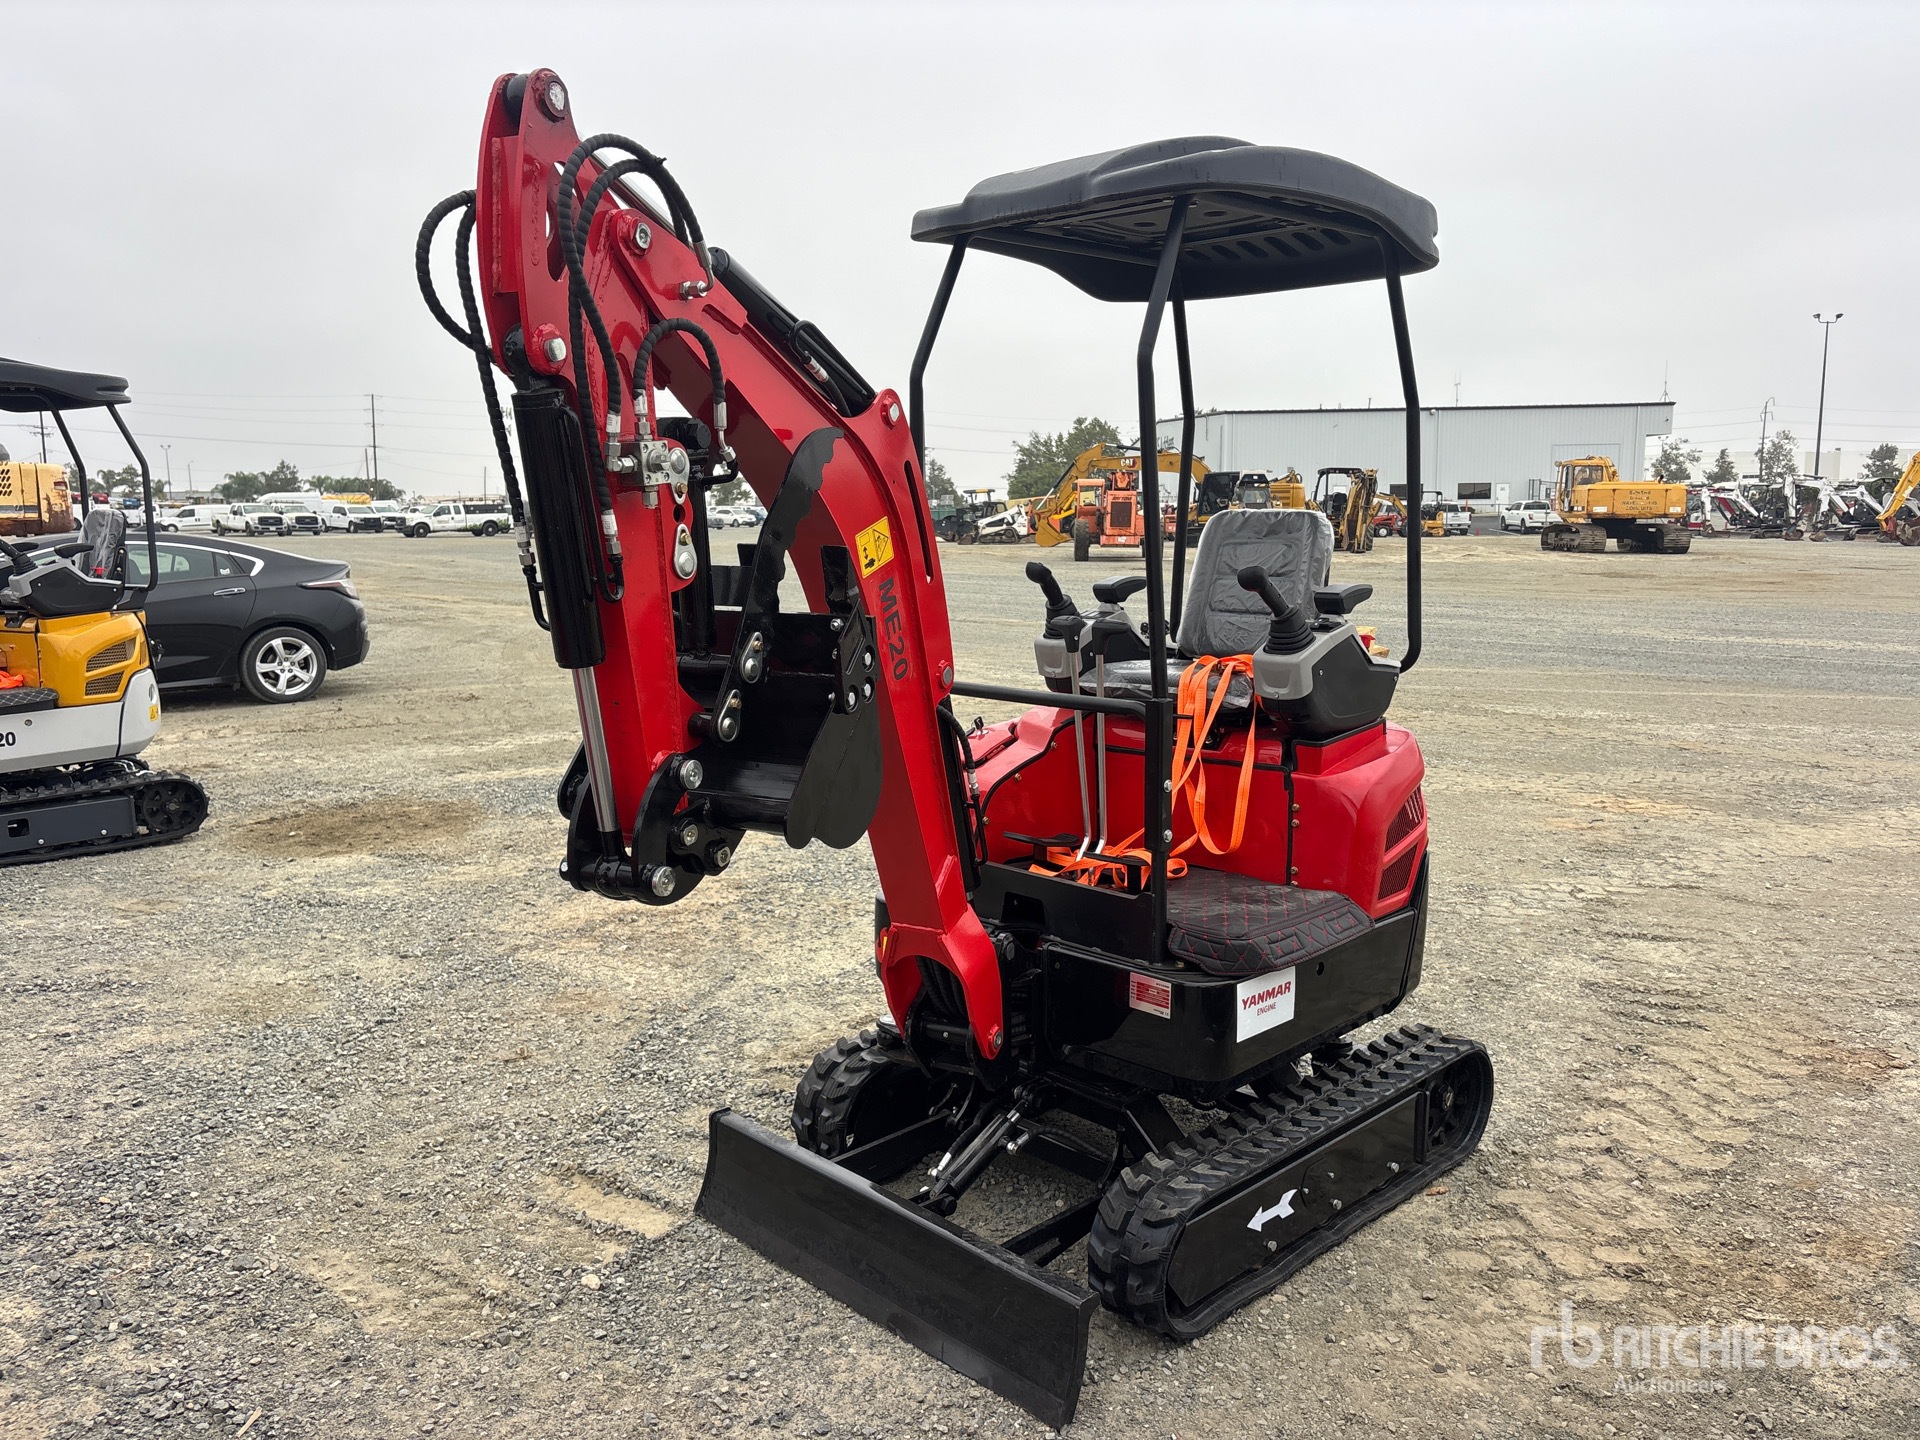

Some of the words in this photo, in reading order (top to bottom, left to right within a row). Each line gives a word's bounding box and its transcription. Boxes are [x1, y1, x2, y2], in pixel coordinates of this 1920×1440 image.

[1120, 458, 1134, 467] CAT
[878, 577, 909, 681] ME20
[1241, 981, 1292, 1010] YANMAR
[1256, 1002, 1277, 1016] ENGINE
